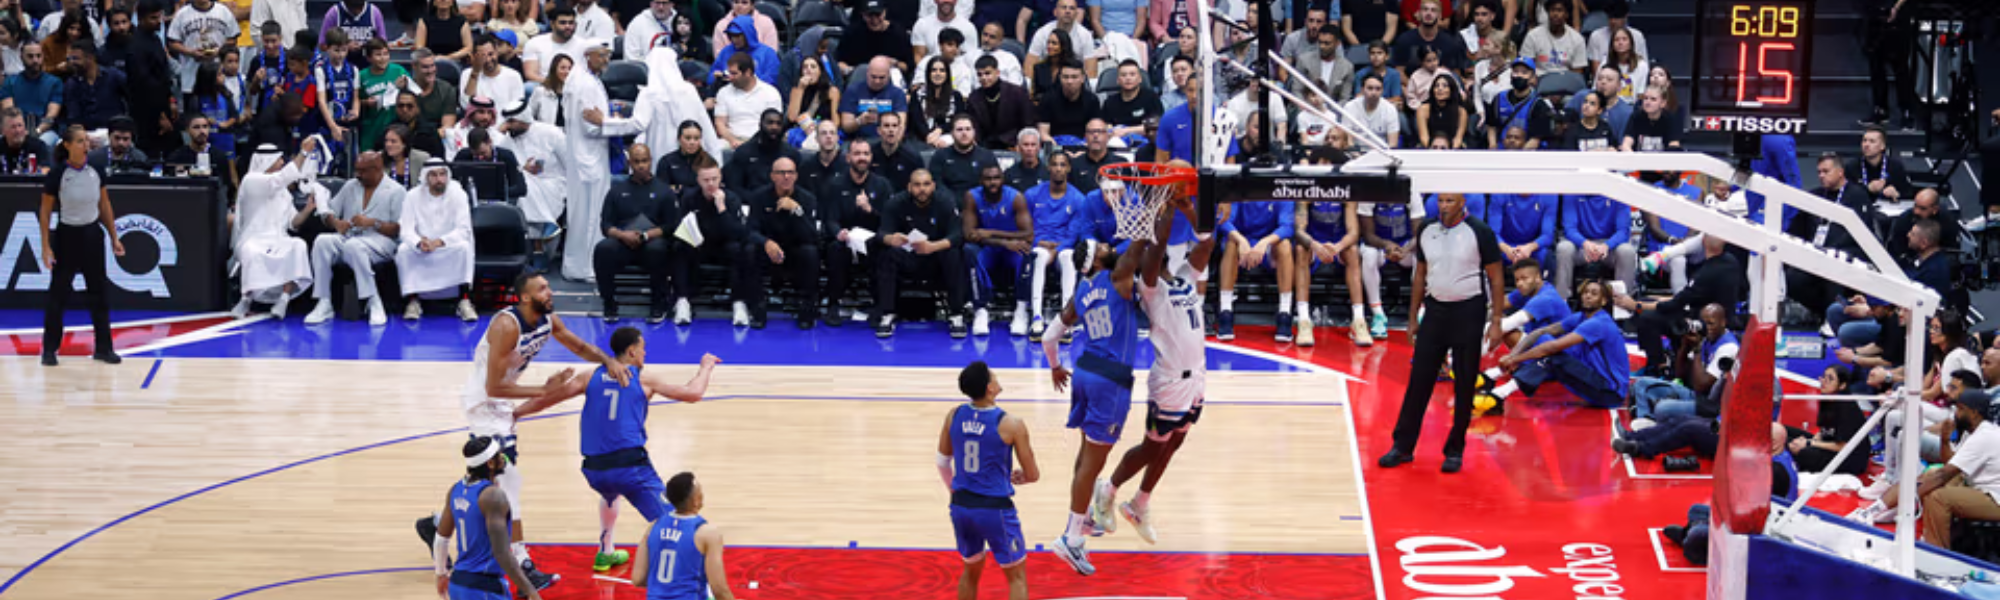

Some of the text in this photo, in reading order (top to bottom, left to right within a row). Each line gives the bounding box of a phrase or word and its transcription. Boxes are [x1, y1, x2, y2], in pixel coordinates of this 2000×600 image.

[1731, 5, 1798, 37] 6:09
[1737, 41, 1794, 104] 15
[1720, 116, 1807, 134] TISSOT
[1272, 185, 1351, 199] abu dhabi
[1083, 305, 1114, 340] 88
[603, 388, 620, 421] 7
[964, 440, 980, 473] 8
[458, 517, 468, 552] 1
[656, 549, 677, 583] 0
[1395, 535, 1548, 600] ab
